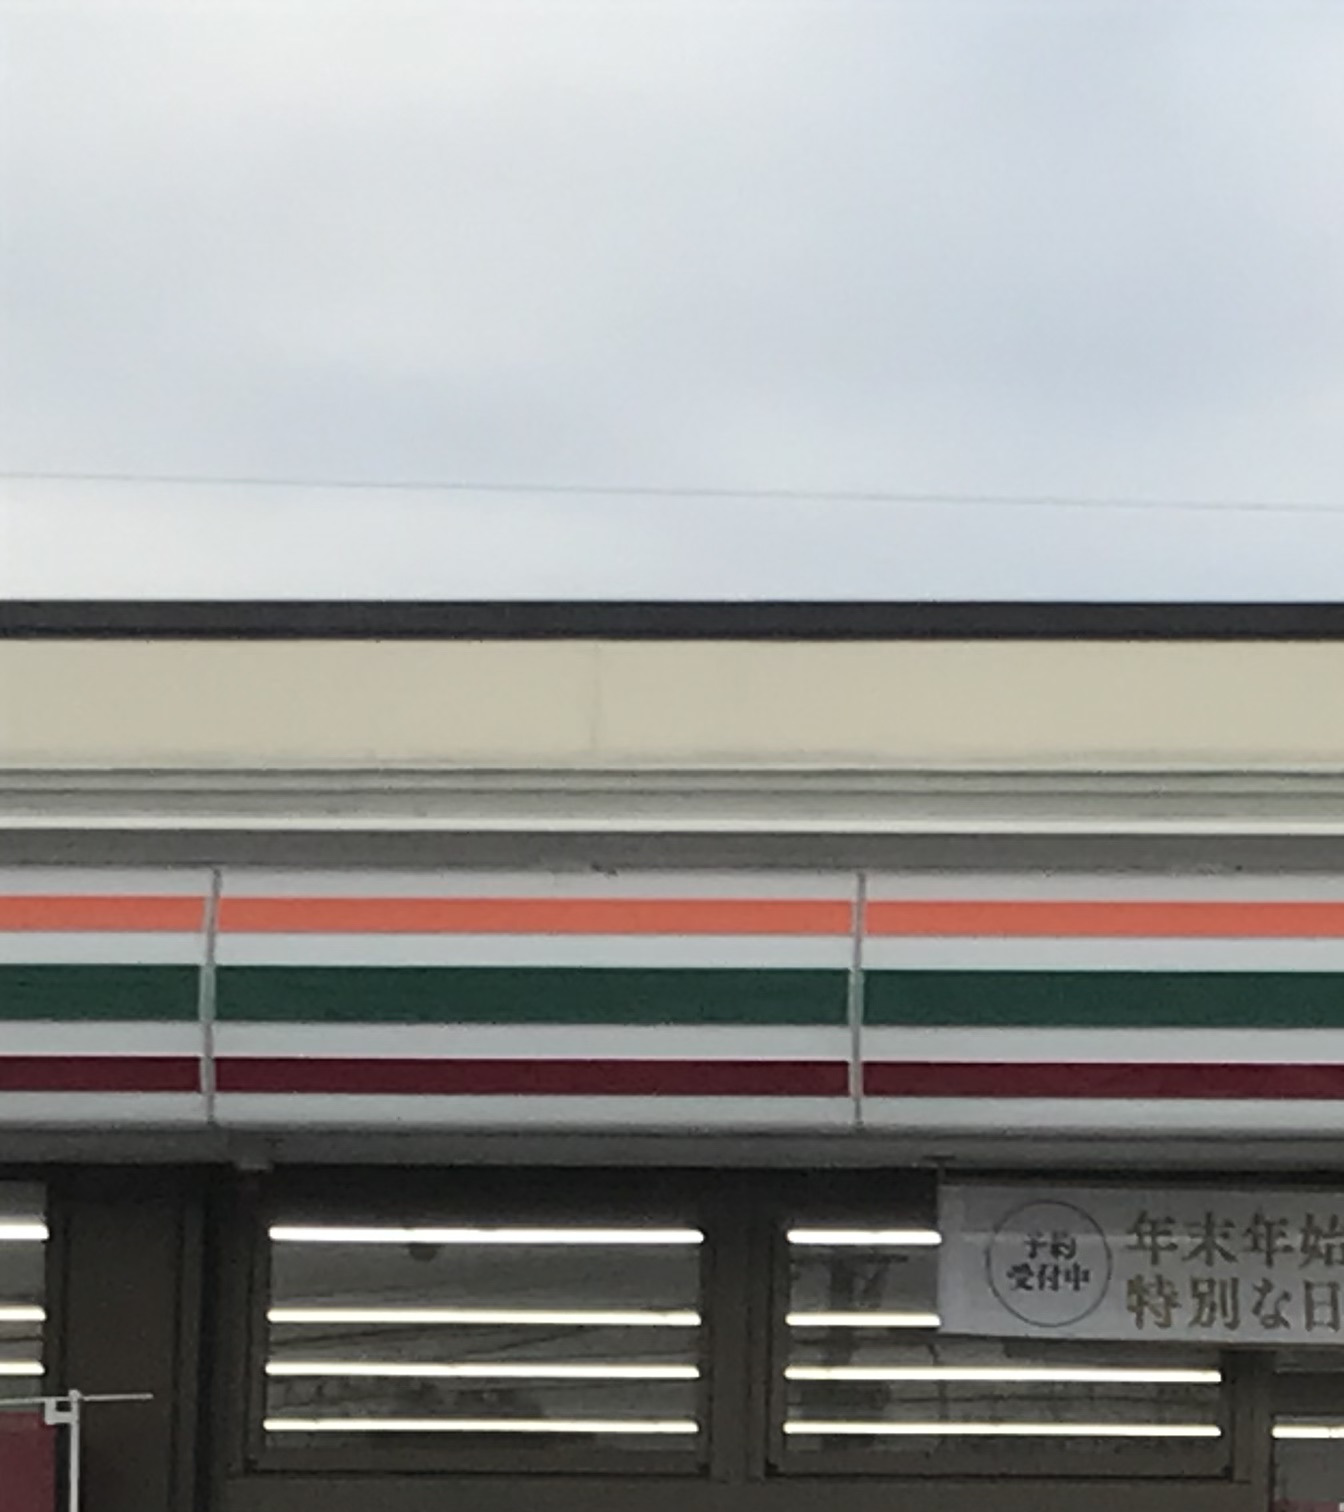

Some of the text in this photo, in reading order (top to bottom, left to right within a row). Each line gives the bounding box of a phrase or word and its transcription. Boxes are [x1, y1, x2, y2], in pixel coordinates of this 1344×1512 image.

[1023, 1232, 1077, 1259] 予約
[1007, 1263, 1091, 1293] 受付中
